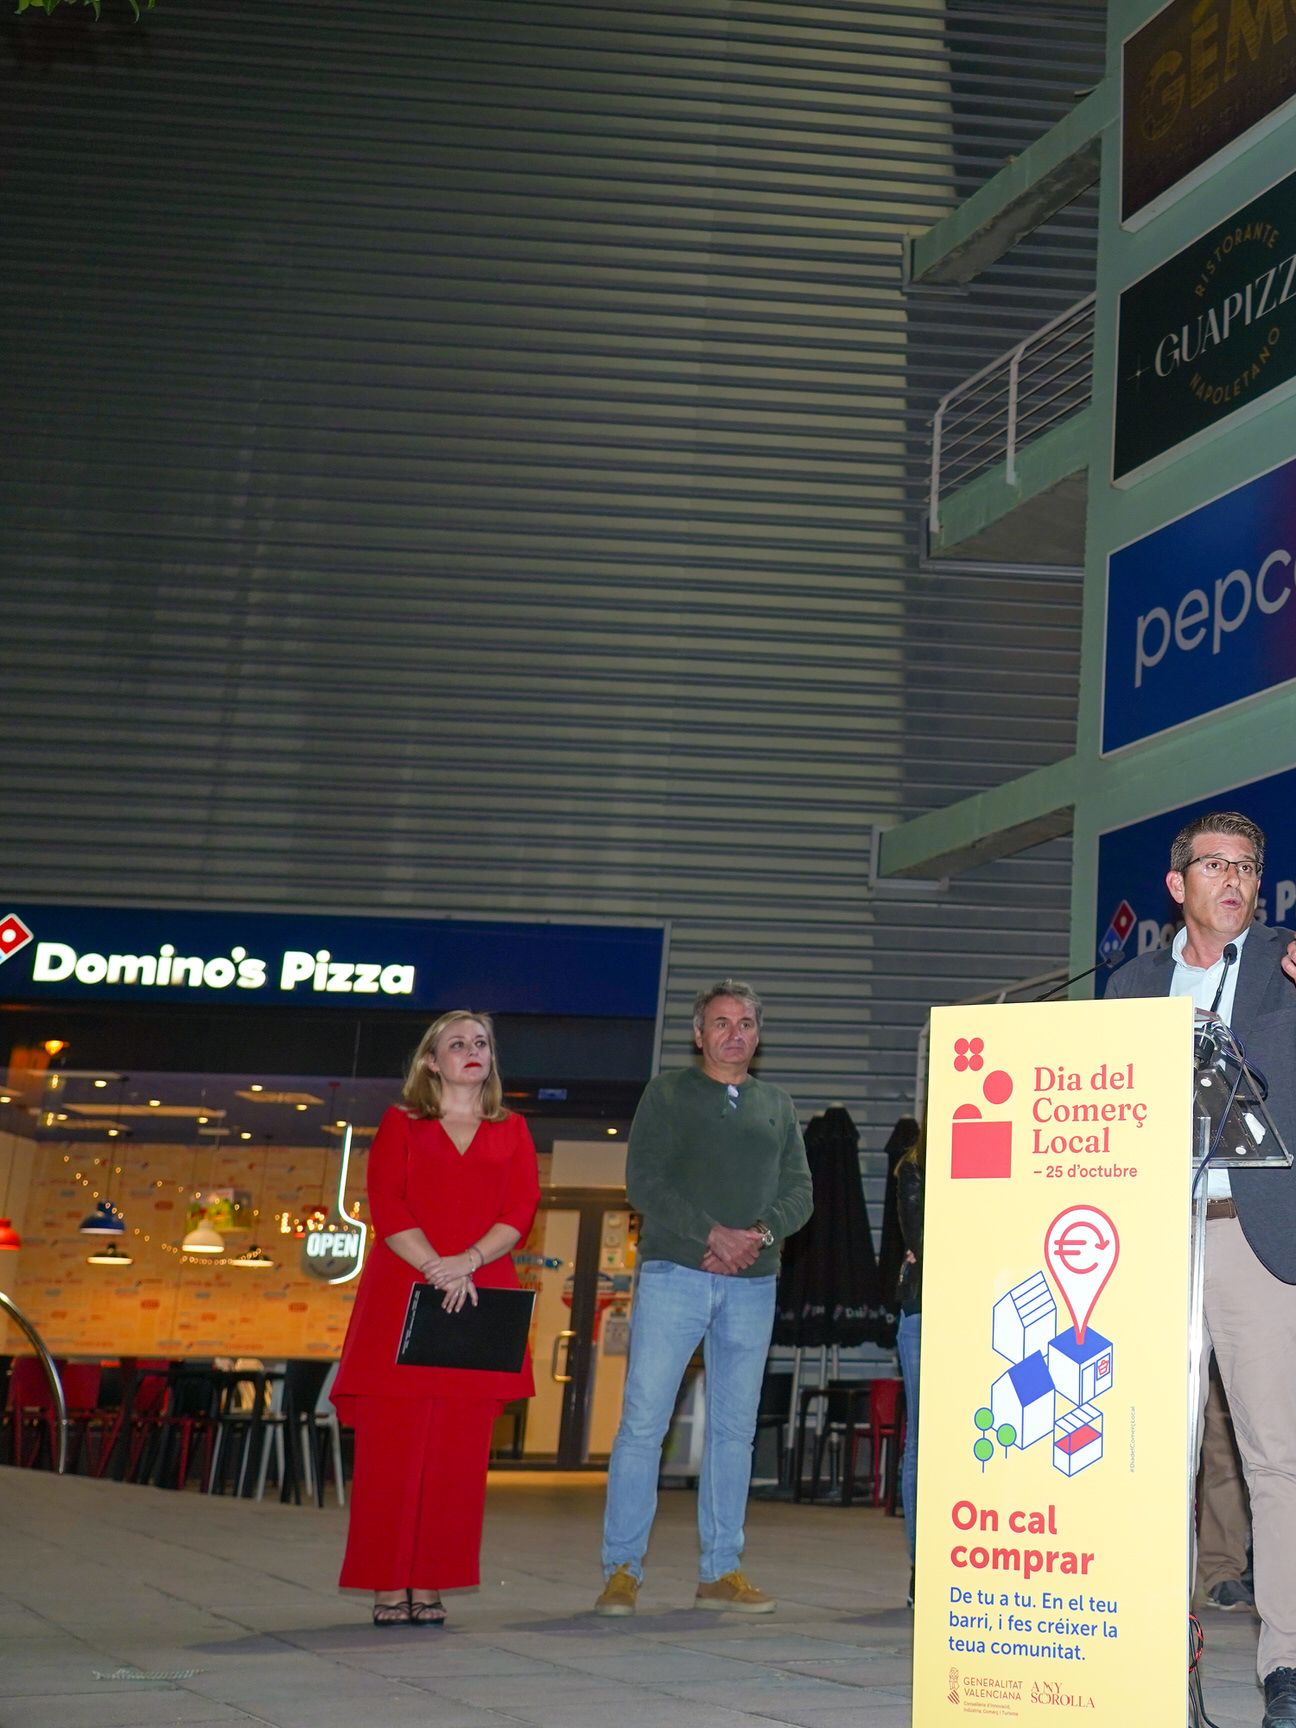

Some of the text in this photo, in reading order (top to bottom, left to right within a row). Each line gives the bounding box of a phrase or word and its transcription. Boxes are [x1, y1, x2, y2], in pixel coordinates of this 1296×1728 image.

[1194, 222, 1280, 297] RISTORANTE
[1189, 327, 1281, 405] NAPOLETANO
[32, 942, 415, 994] Domino's Pizza
[1034, 1063, 1135, 1092] Dia del
[1032, 1097, 1148, 1128] Comerç
[1032, 1127, 1110, 1154] Local
[1046, 1165, 1063, 1178] 25
[1068, 1164, 1138, 1178] d'octubre
[307, 1232, 359, 1258] OPEN
[951, 1500, 1057, 1535] On cal
[950, 1545, 1094, 1579] comprar
[950, 1587, 1118, 1613] De tu a tu. En el teu
[949, 1612, 1118, 1638] barri, i fes créixer la
[949, 1636, 1086, 1660] teua comunitat.
[963, 1676, 1023, 1689] GENERALITAT
[964, 1687, 1022, 1700] VALENCIANA
[1031, 1681, 1063, 1694] ANY
[1031, 1692, 1095, 1708] SOROLLA
